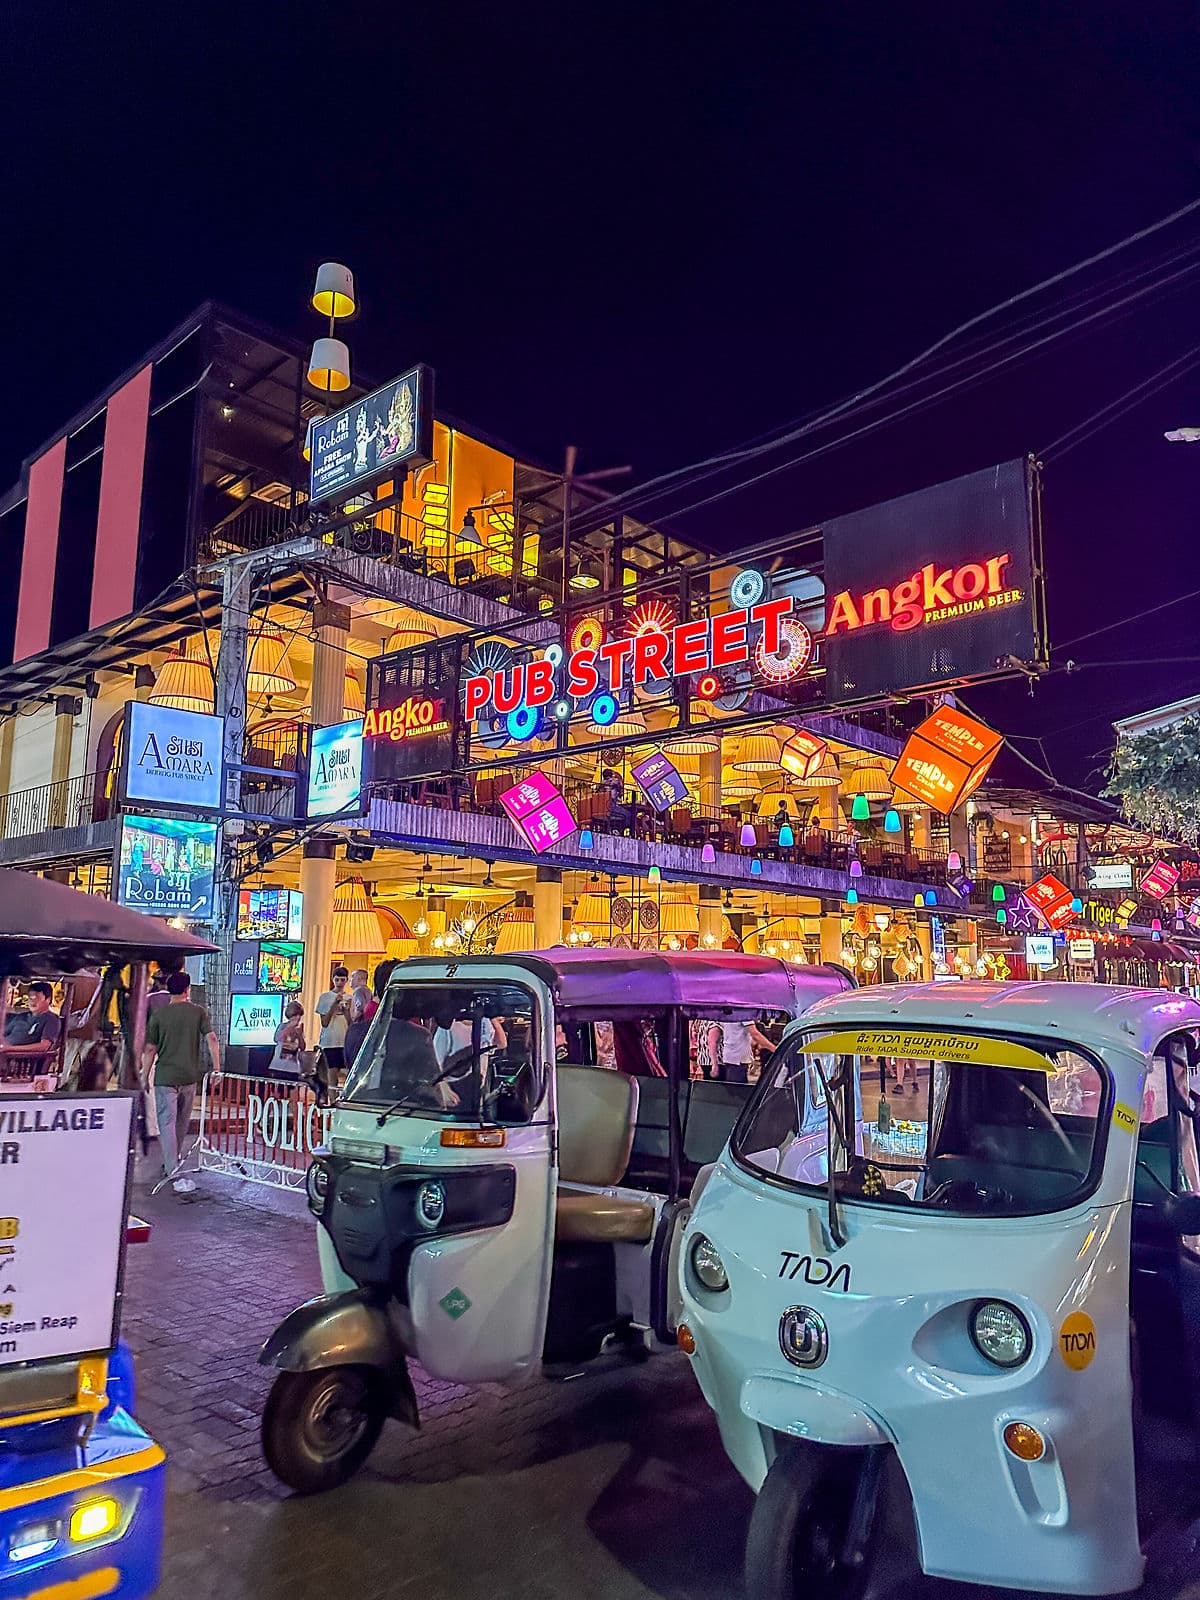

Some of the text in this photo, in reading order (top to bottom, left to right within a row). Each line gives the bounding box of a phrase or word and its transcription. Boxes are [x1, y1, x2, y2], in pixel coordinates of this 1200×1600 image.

[318, 431, 349, 453] Robam
[324, 448, 342, 465] FREE
[825, 553, 1009, 636] Angkor
[925, 589, 1023, 623] PREMIUM BEER
[463, 596, 795, 723] PUB STREET
[405, 721, 449, 737] PREMIUM BEER
[935, 719, 985, 751] TEMPLE
[137, 733, 214, 776] AMARA
[314, 752, 356, 785] AMARA
[906, 758, 955, 793] TEMPLE
[518, 783, 541, 807] TEMPLE
[539, 809, 560, 841] TEMPLE
[125, 876, 192, 902] Robam
[1049, 902, 1073, 921] TEMPL
[1088, 901, 1115, 927] Tiger
[235, 1008, 277, 1028] AMARA
[872, 1034, 901, 1044] TADA
[856, 1045, 874, 1053] Ride
[900, 1047, 936, 1057] Support
[938, 1051, 970, 1060] drivers
[778, 1251, 851, 1292] TADA
[0, 1315, 78, 1334] Siem Reap
[1061, 1334, 1096, 1353] TADA
